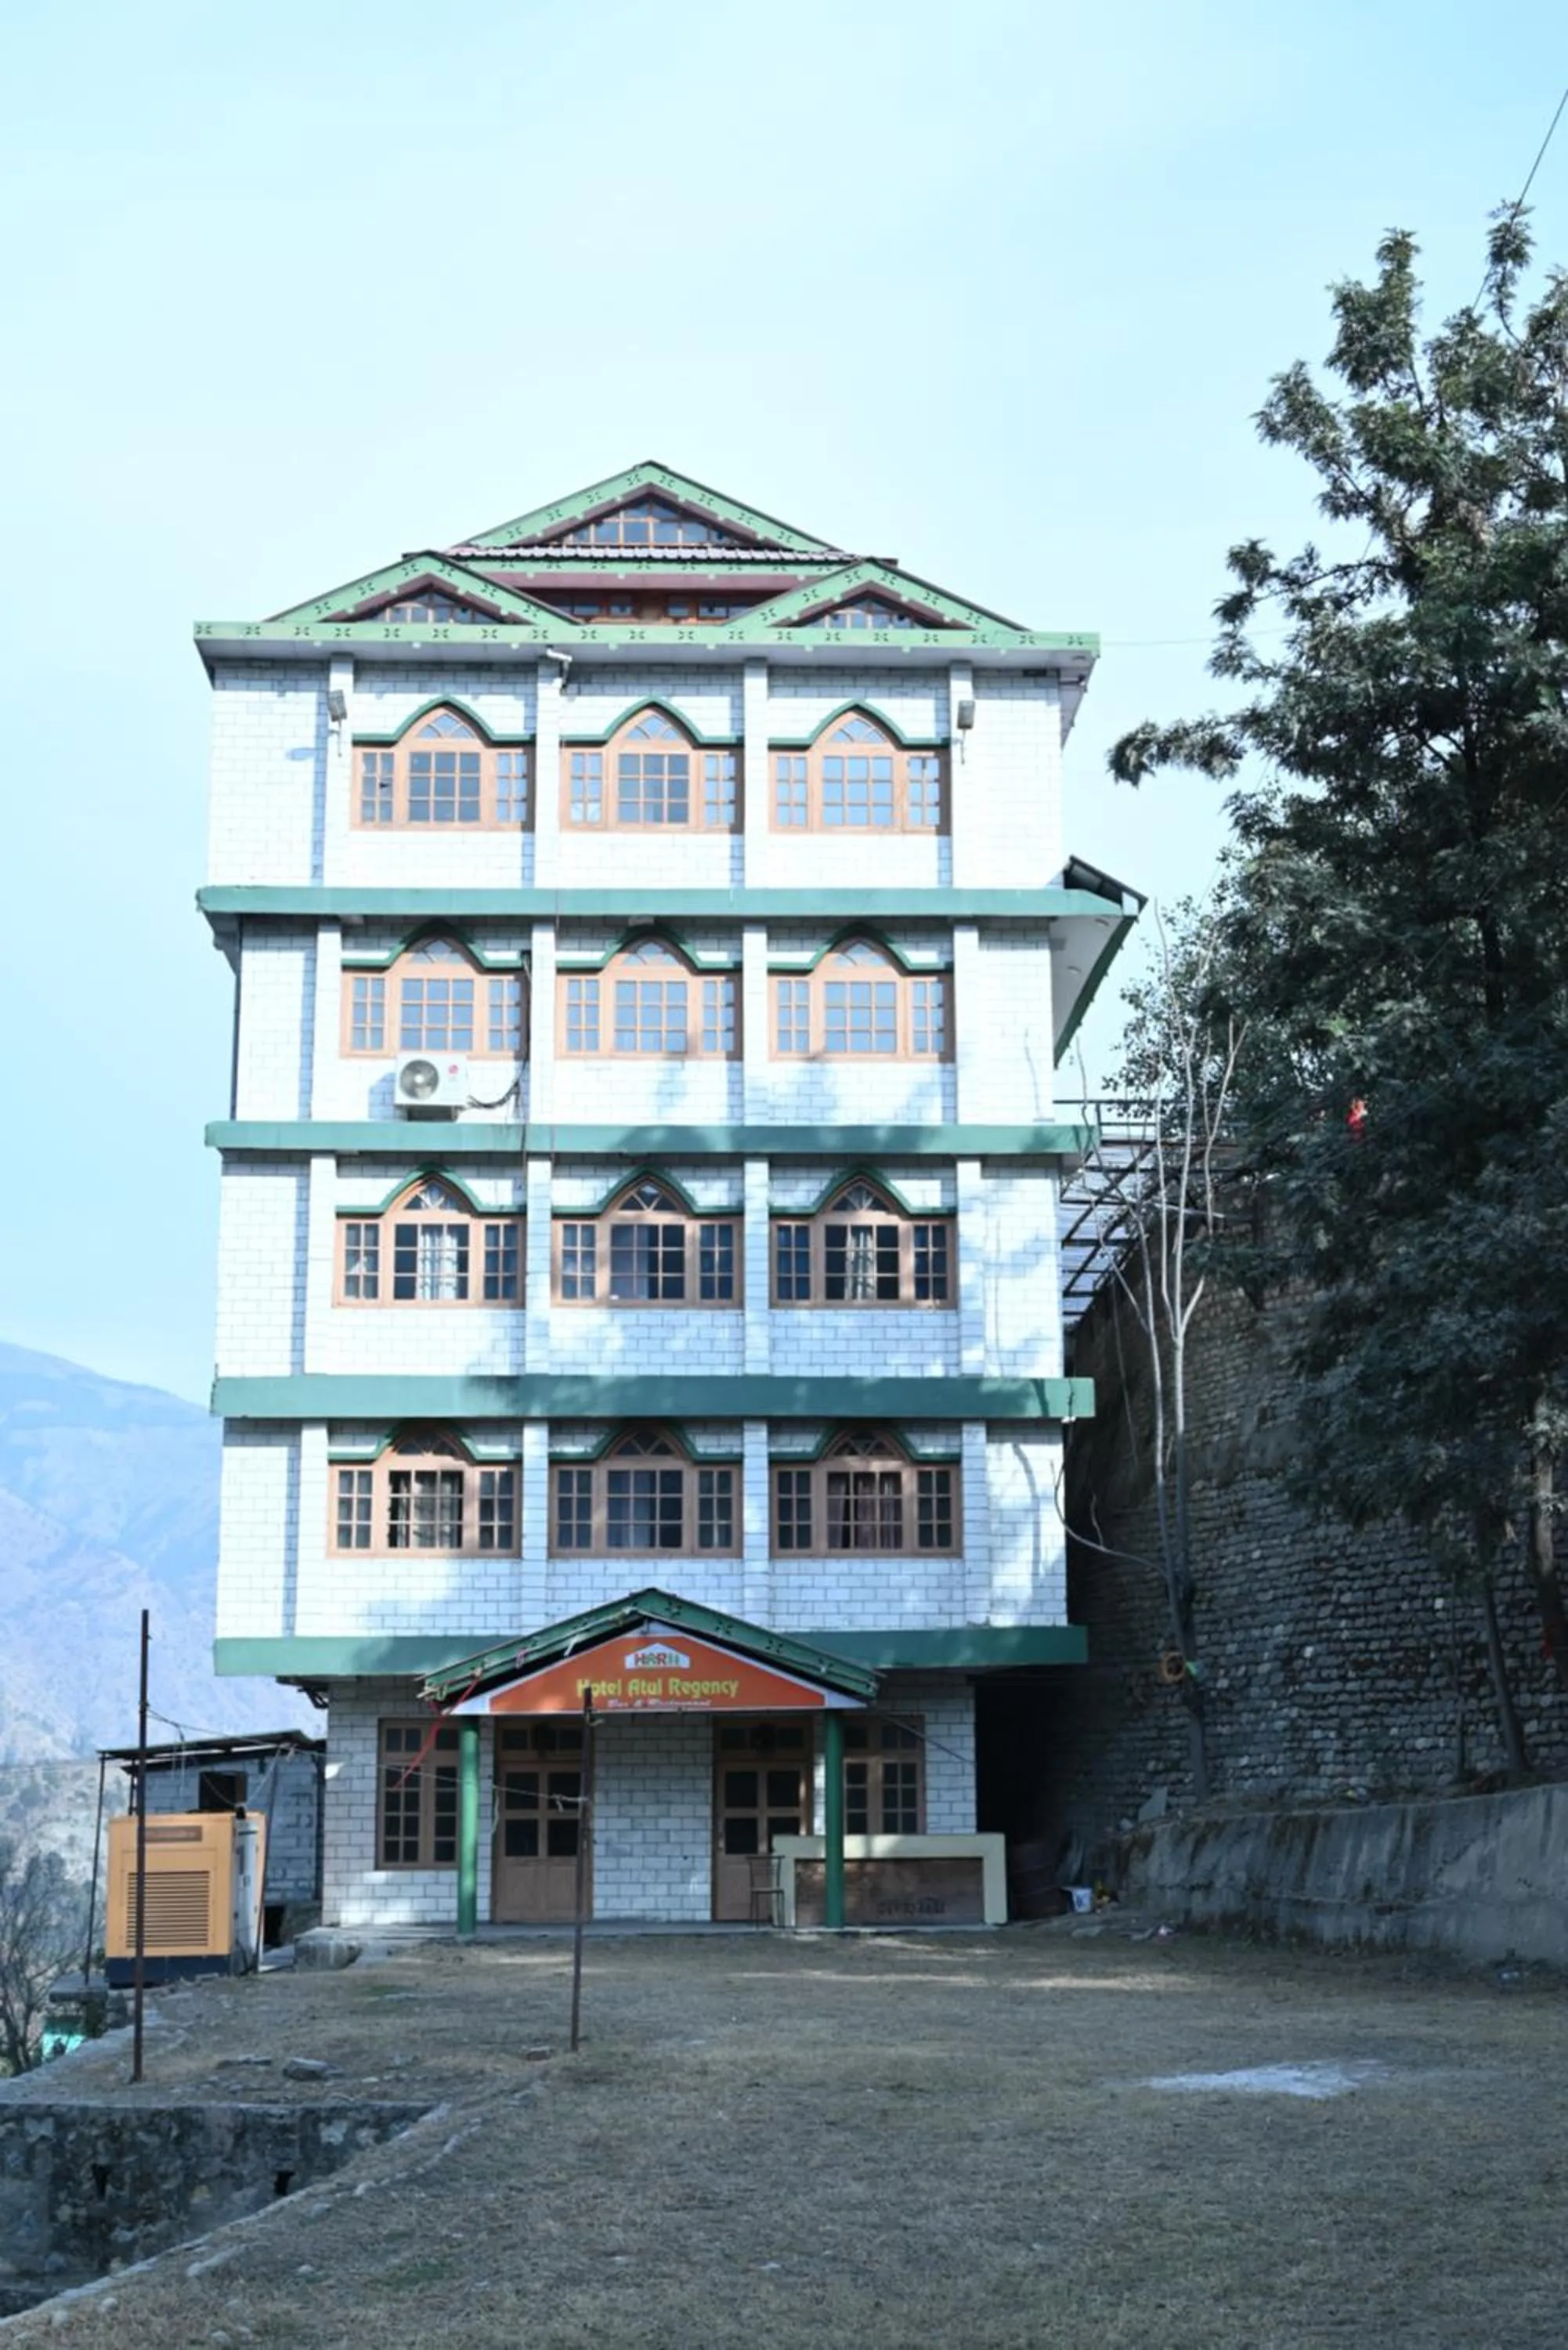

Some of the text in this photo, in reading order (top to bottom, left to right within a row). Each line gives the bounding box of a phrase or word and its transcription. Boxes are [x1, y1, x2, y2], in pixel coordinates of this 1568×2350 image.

[576, 1679, 739, 1698] Hotel Atul Regency
